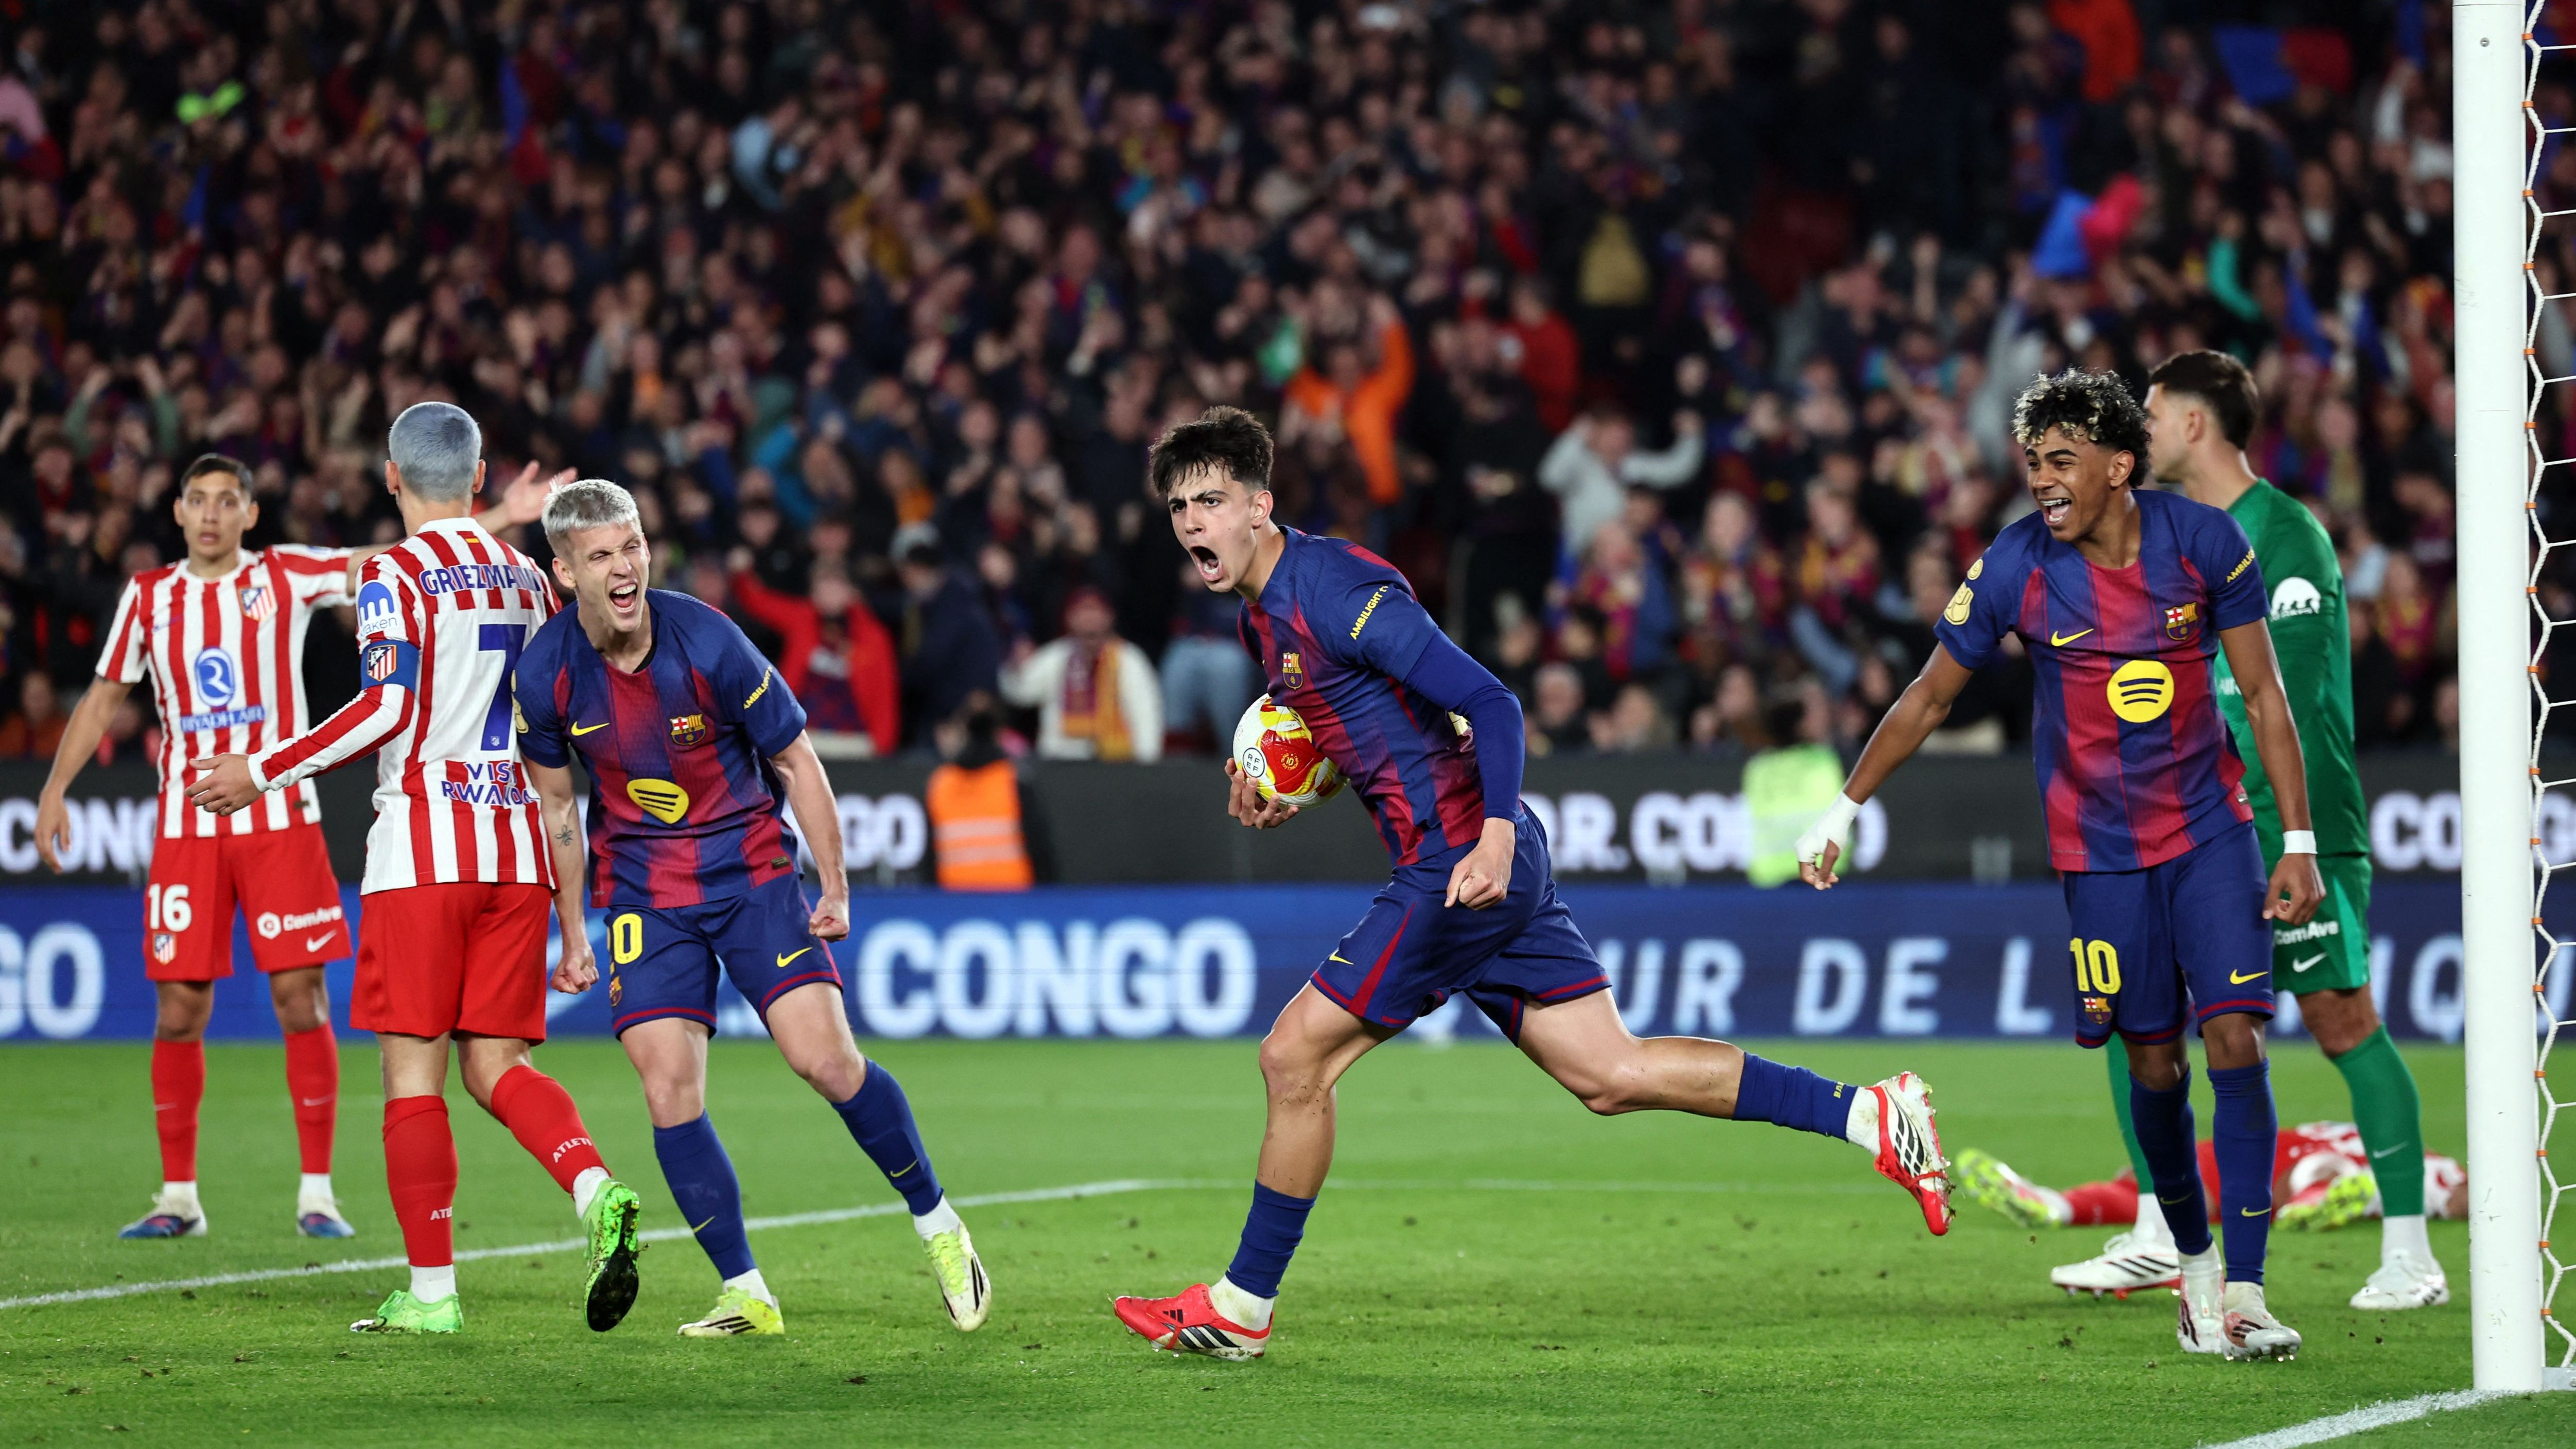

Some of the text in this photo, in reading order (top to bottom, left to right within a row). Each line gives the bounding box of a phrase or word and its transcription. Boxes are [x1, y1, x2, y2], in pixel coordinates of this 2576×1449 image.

[1350, 591, 1383, 640] AMBILIGHT
[479, 624, 526, 750] 7
[149, 884, 192, 931] 16
[284, 905, 342, 931] ComAve
[607, 913, 643, 973] 0
[2069, 937, 2121, 994] 10
[857, 918, 1257, 1039] CONGO
[1794, 937, 1949, 1036] DE
[552, 1137, 593, 1164] ATLETI
